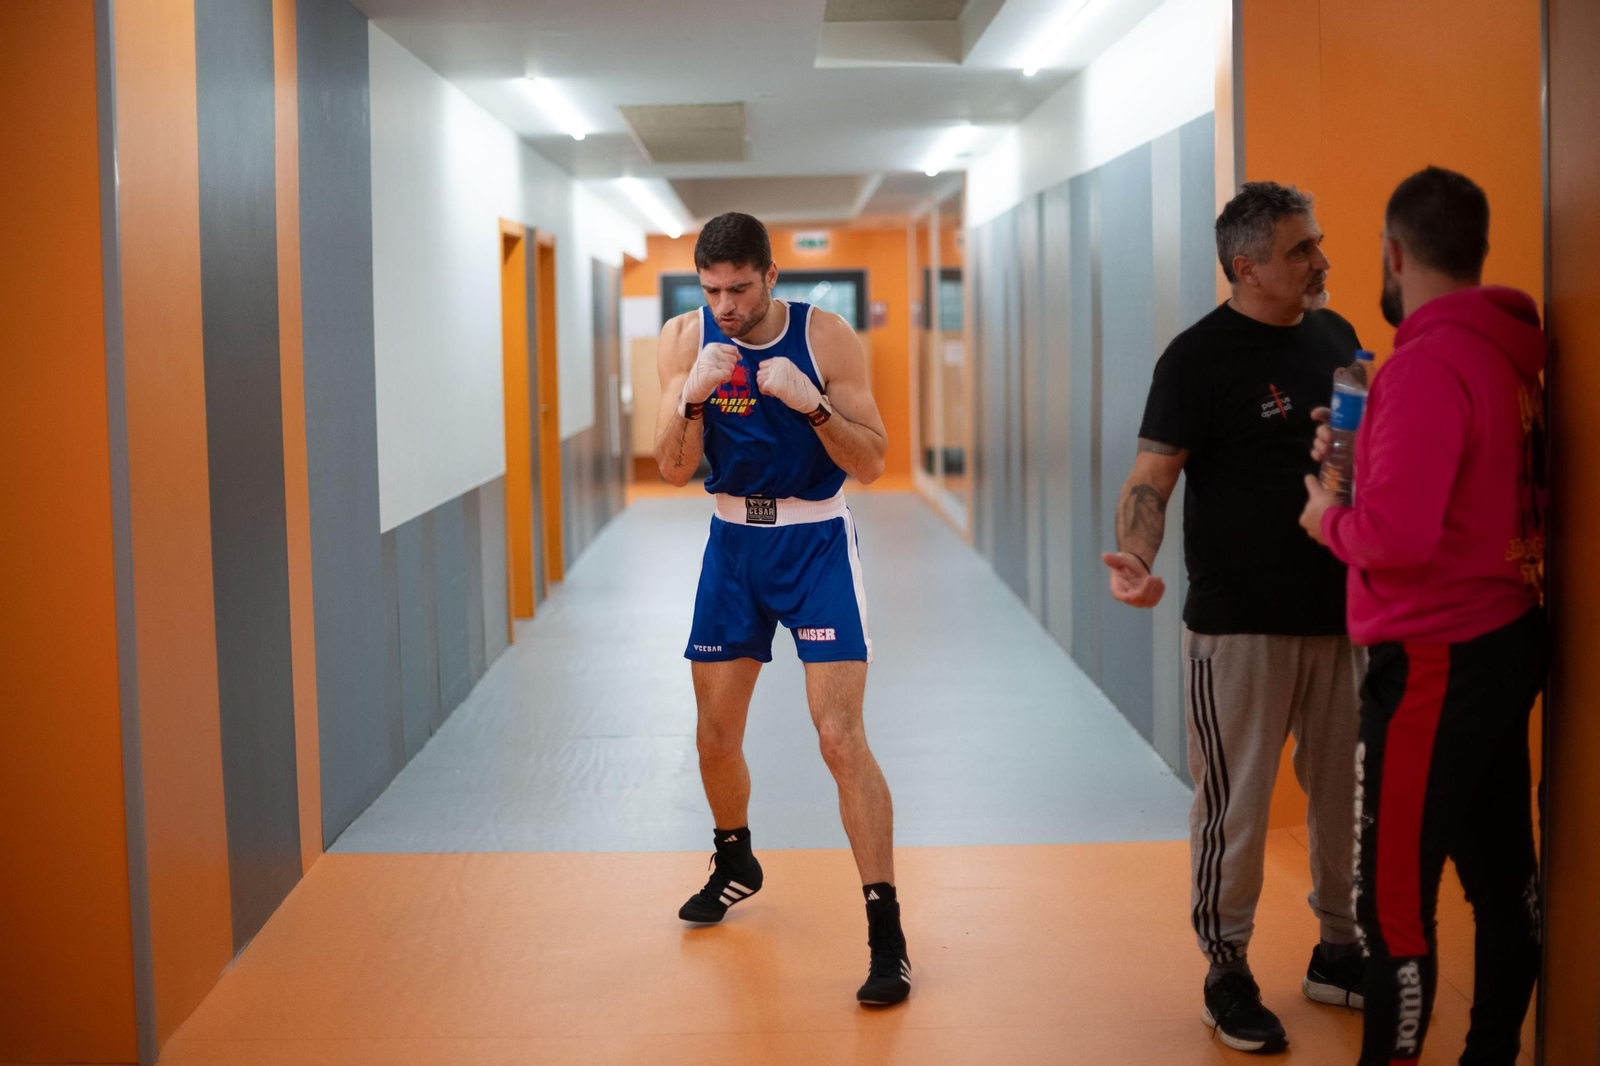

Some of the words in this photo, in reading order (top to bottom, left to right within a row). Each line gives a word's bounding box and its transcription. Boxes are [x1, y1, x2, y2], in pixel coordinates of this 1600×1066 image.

[710, 398, 756, 406] SPARTAN
[721, 405, 747, 413] TEAM
[749, 507, 774, 515] CESAR
